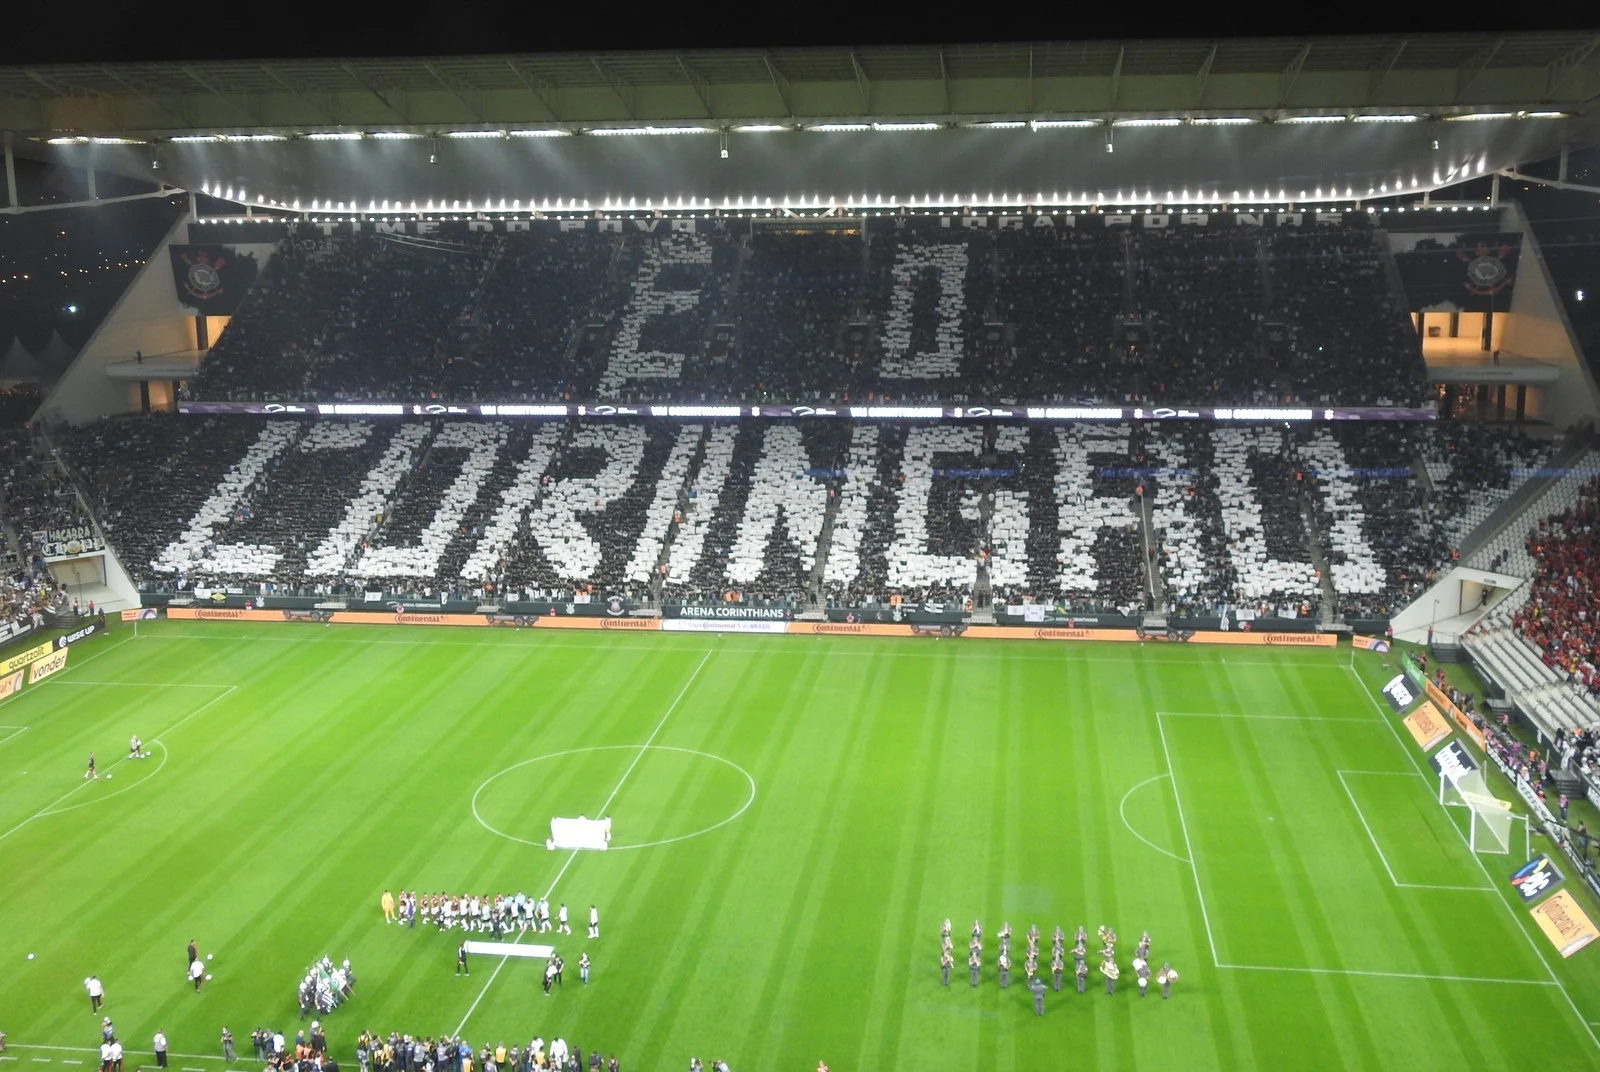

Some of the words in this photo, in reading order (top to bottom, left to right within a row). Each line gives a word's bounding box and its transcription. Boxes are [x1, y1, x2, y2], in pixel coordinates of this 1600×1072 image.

[315, 221, 440, 236] TIME
[680, 607, 715, 618] ARENA
[716, 608, 784, 619] CORINTHIANS
[600, 619, 648, 630] Continental
[813, 623, 861, 634] Continental
[84, 625, 95, 636] UP
[1263, 634, 1316, 645] Continental
[9, 647, 45, 671] quartzolit
[33, 655, 66, 680] vonder
